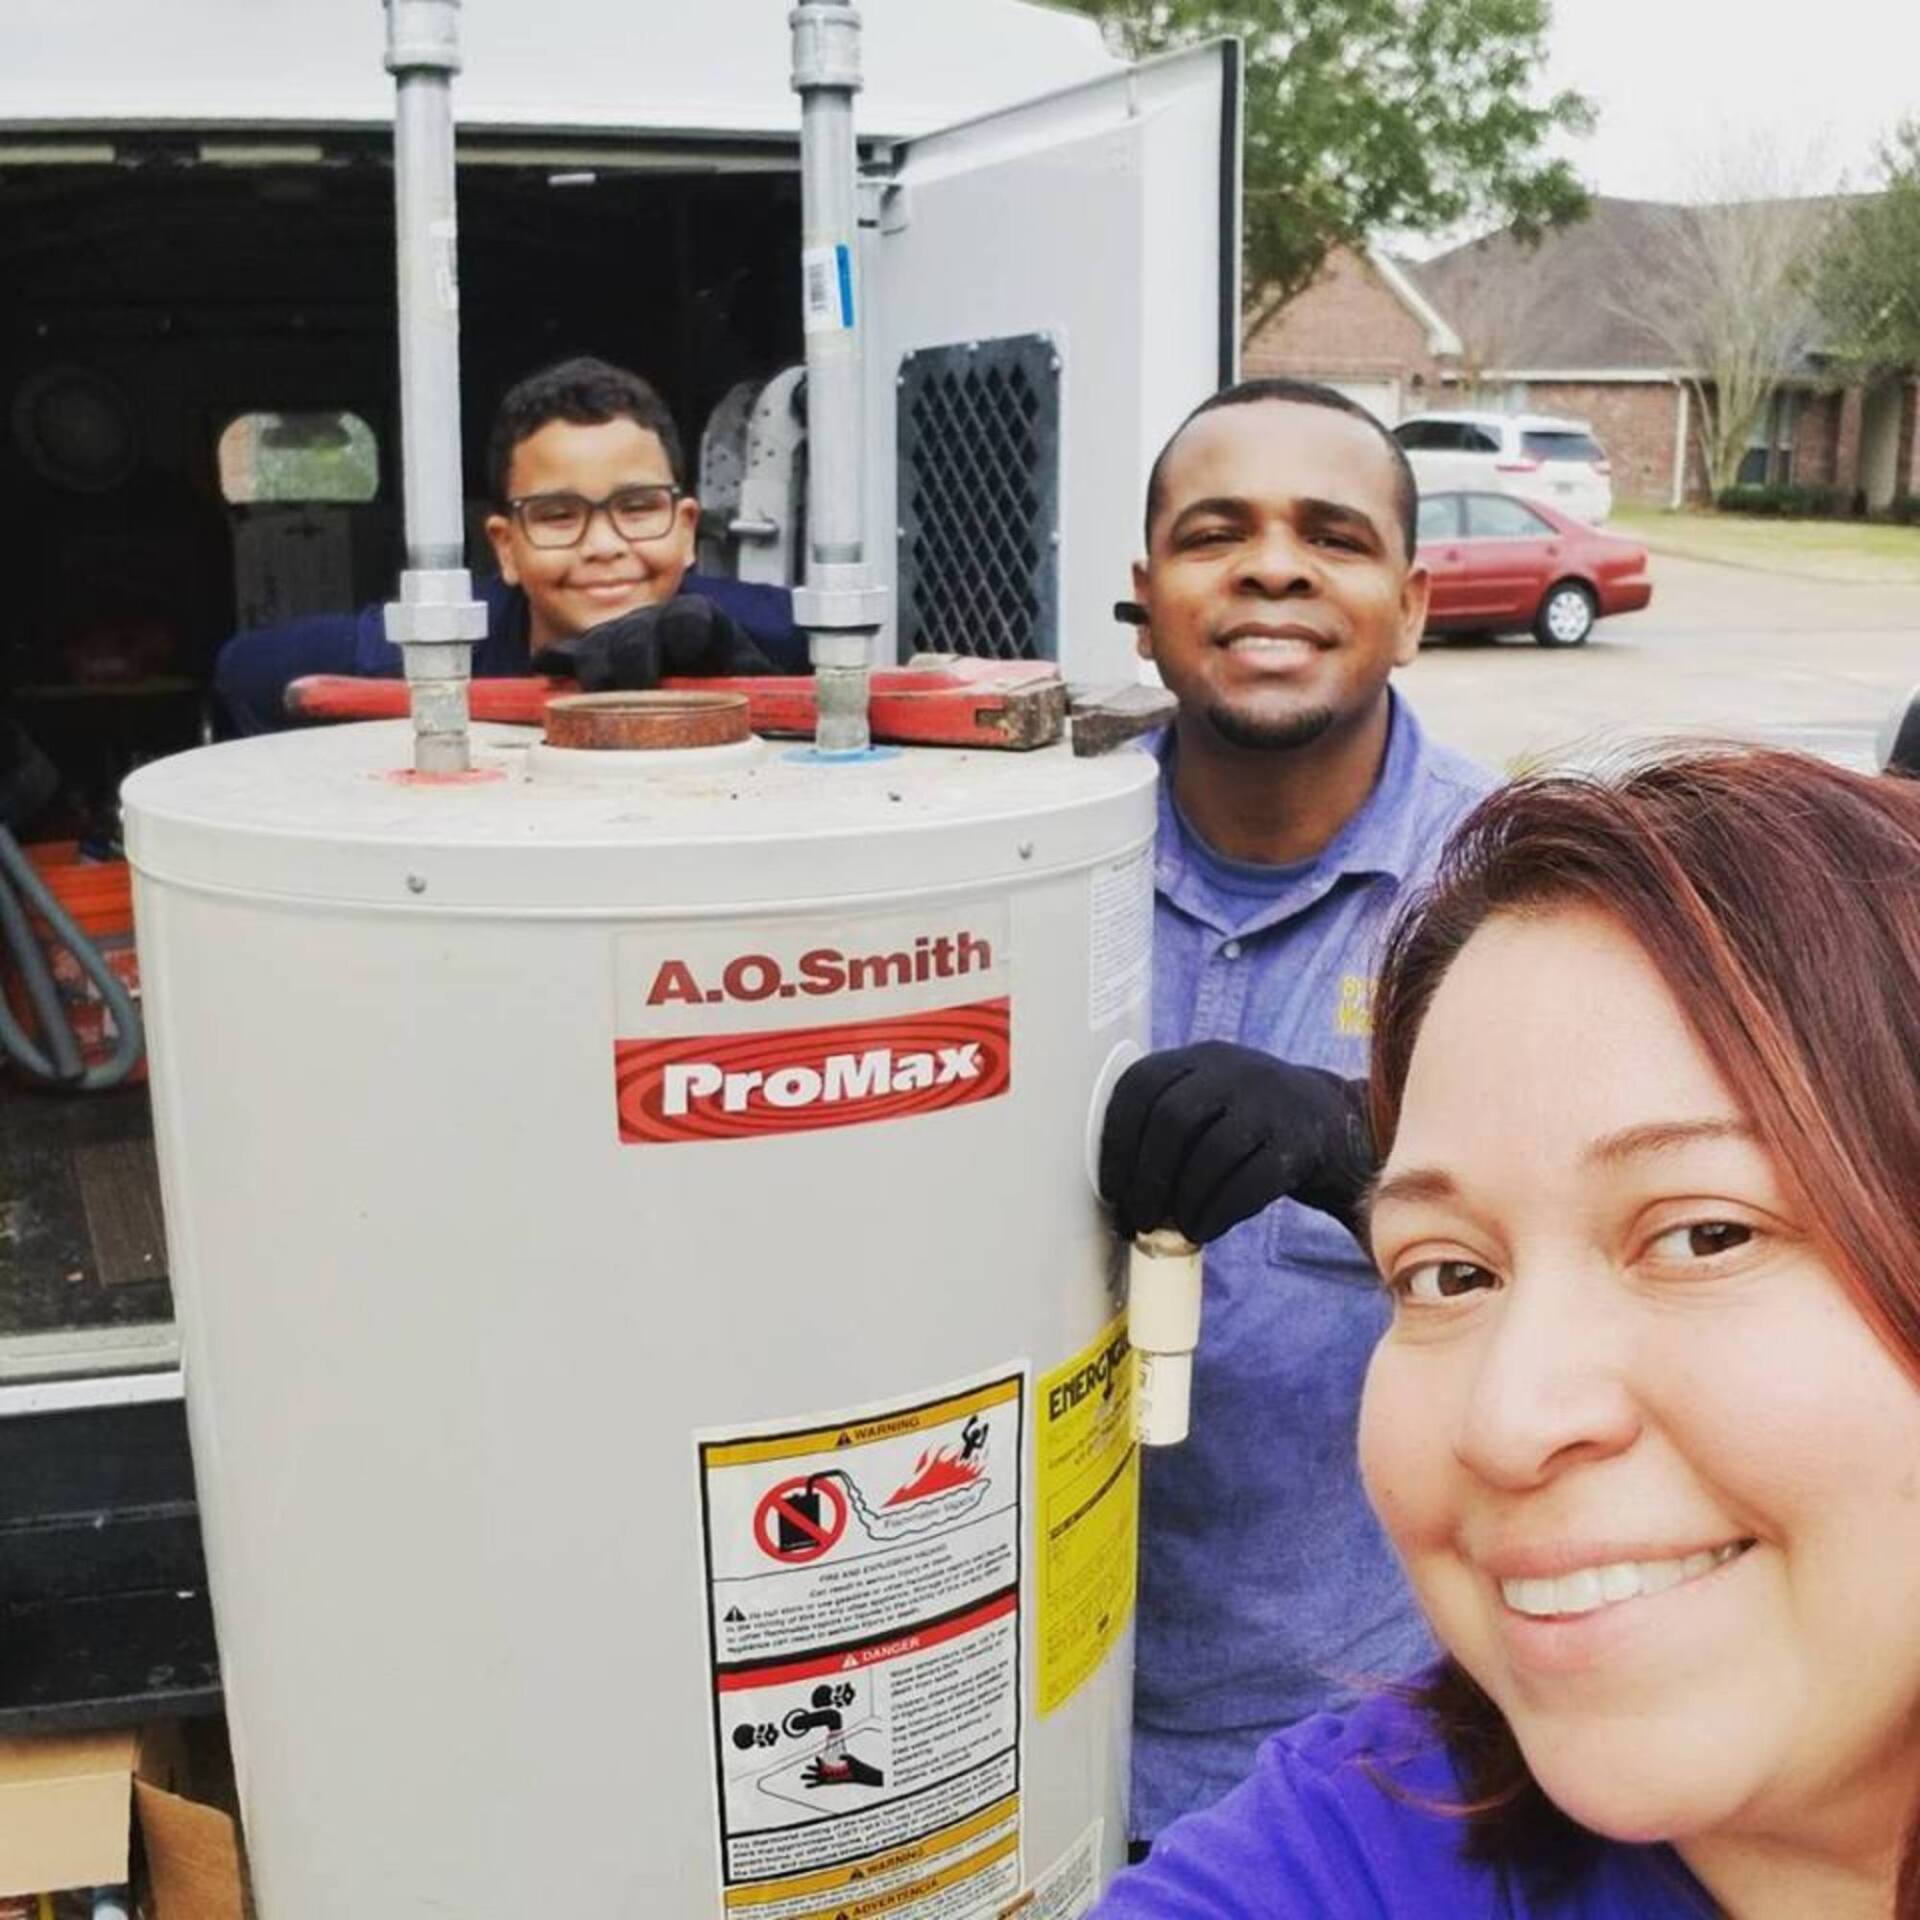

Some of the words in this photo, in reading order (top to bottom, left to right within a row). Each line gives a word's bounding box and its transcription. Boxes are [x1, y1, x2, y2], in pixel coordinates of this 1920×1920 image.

[661, 1042, 981, 1116] ProMax
[854, 1416, 919, 1439] WARNING
[863, 1636, 919, 1661] DANGER
[868, 1846, 924, 1873] WARNING
[853, 1877, 938, 1917] ADVERTENCIA
